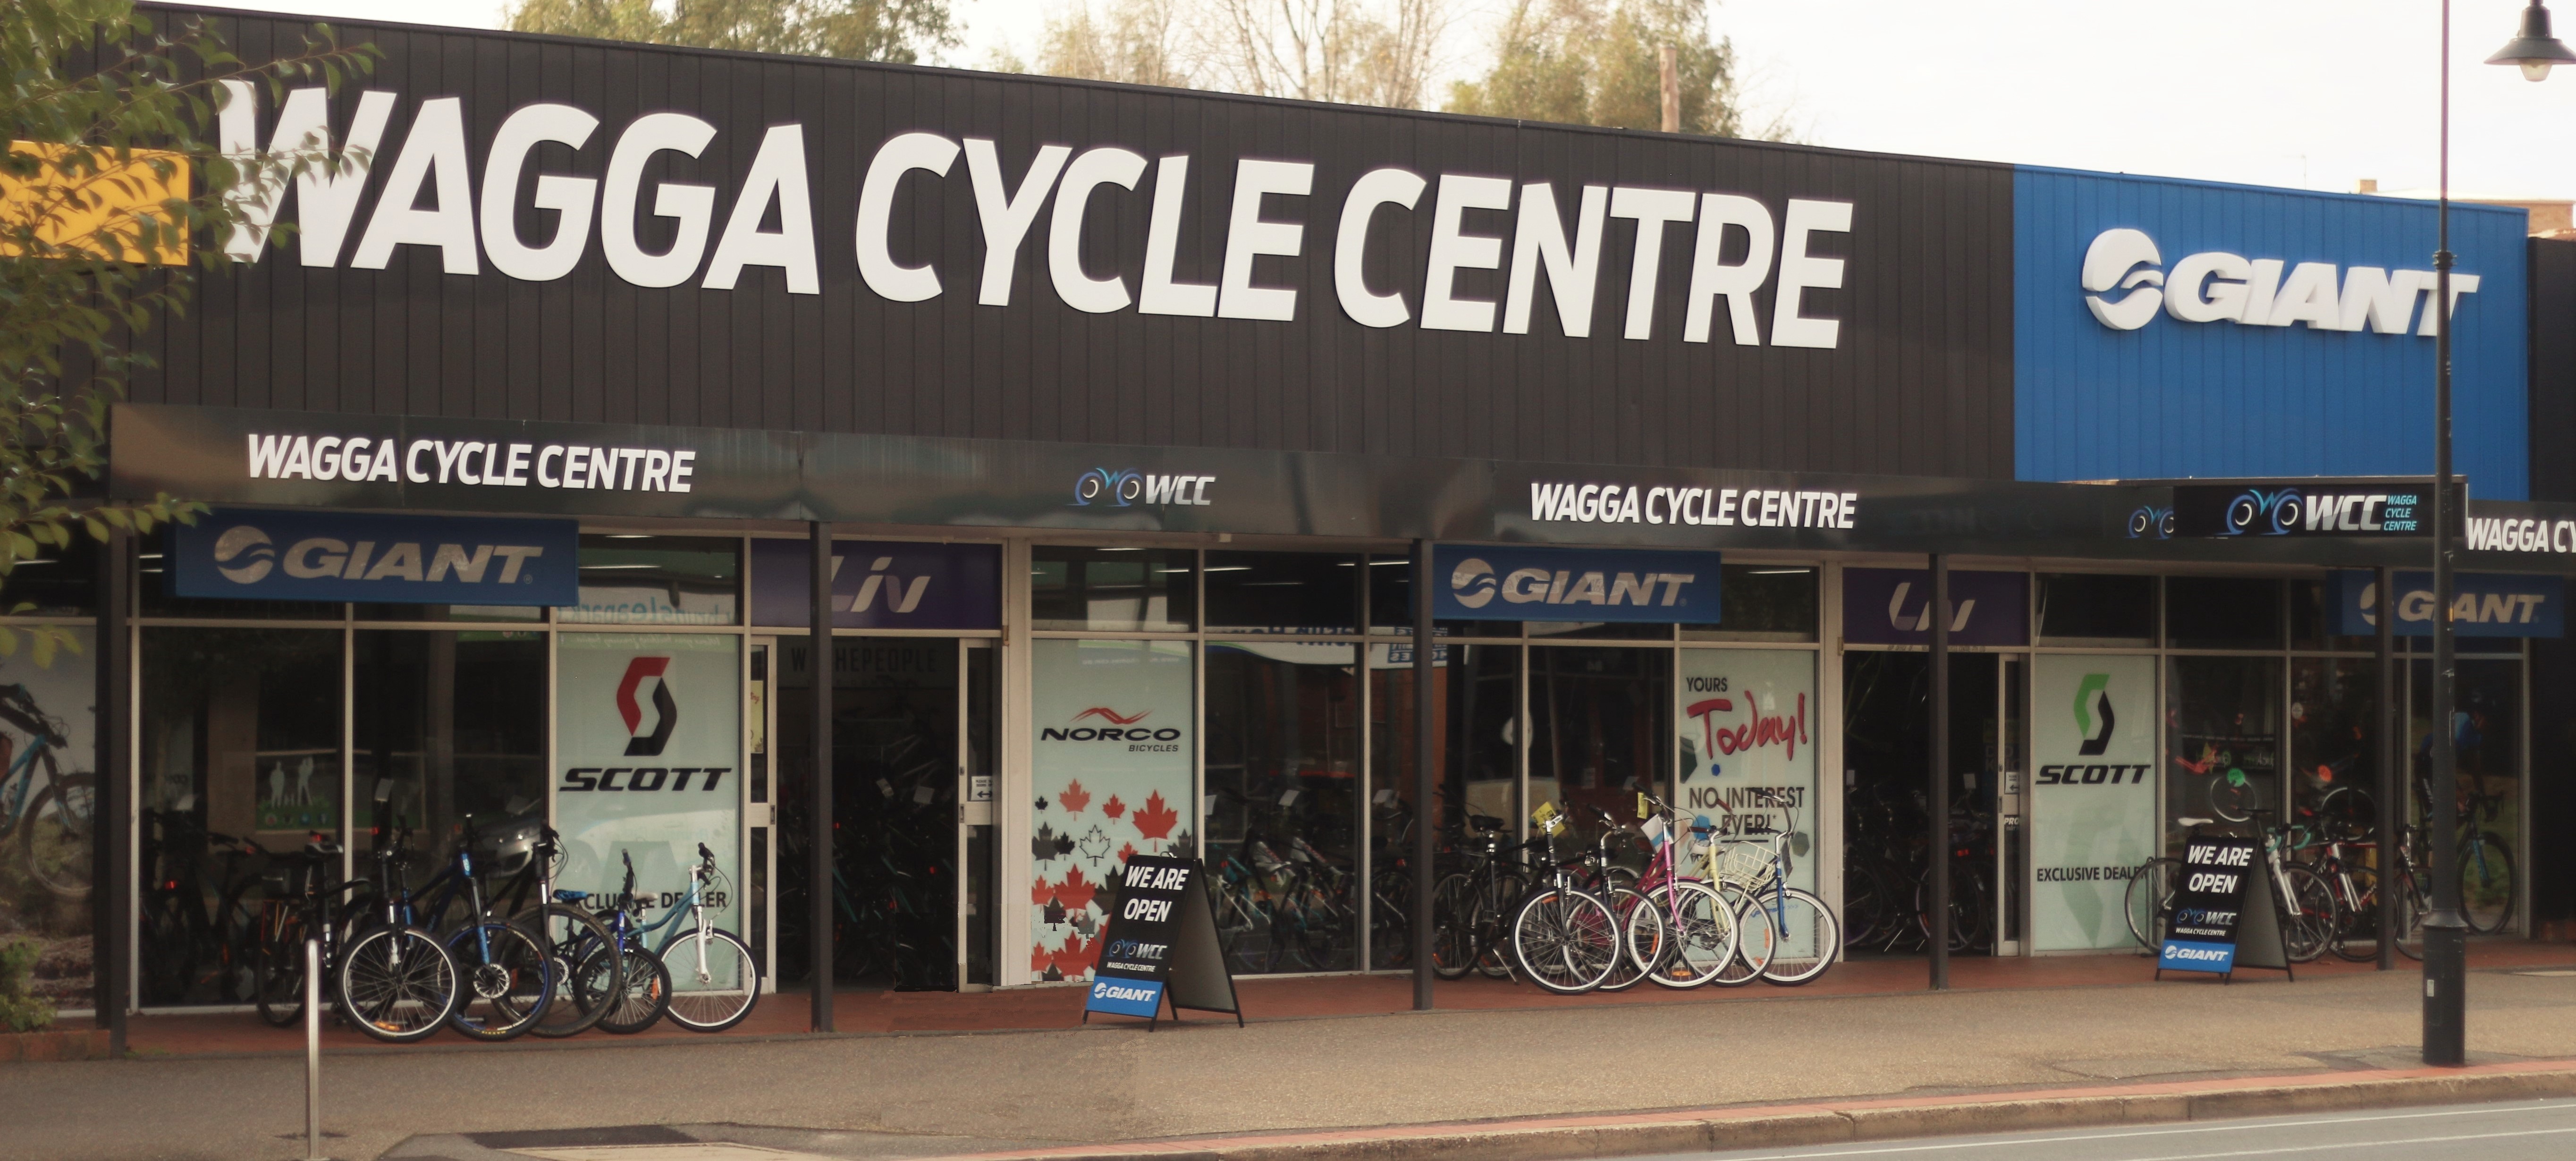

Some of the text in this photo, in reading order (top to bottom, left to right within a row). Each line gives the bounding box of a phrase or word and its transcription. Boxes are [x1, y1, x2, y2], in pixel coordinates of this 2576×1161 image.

[219, 80, 1853, 348] WAGGA CYCLE CENTRE
[2164, 252, 2480, 336] GIANT
[249, 434, 695, 492] WAGGA CYCLE CENTRE
[1146, 475, 1215, 505] WCC
[2388, 495, 2416, 505] WAGGA
[1531, 483, 1857, 528] WAGGA CYCLE CENTRE
[2306, 495, 2387, 530] WCC
[2385, 508, 2411, 518] CYCLE
[2383, 521, 2417, 531] CENTRE
[2468, 518, 2549, 552] WAGGA
[283, 538, 543, 584] GIANT
[1502, 568, 1694, 606] GIANT
[2399, 590, 2545, 623] GANT
[791, 647, 937, 672] WHEPEOPLE
[1686, 677, 1728, 692] YOURS
[1041, 728, 1180, 741] NORCO
[1687, 690, 1807, 761] Today!
[559, 768, 732, 792] SCOTT
[2035, 765, 2151, 785] SCOTT
[1689, 787, 1804, 809] NO INTEREST
[2187, 845, 2253, 866] WE ARE
[1125, 866, 1189, 890] WE ARE
[2037, 867, 2100, 881] EXCLUSIVE
[2188, 873, 2238, 894] OPEN
[1124, 898, 1172, 922] OPEN
[2205, 912, 2237, 925] WCC
[1136, 944, 1167, 959] WCC
[2177, 949, 2228, 961] GIANT
[1106, 986, 1156, 1001] GIANT
